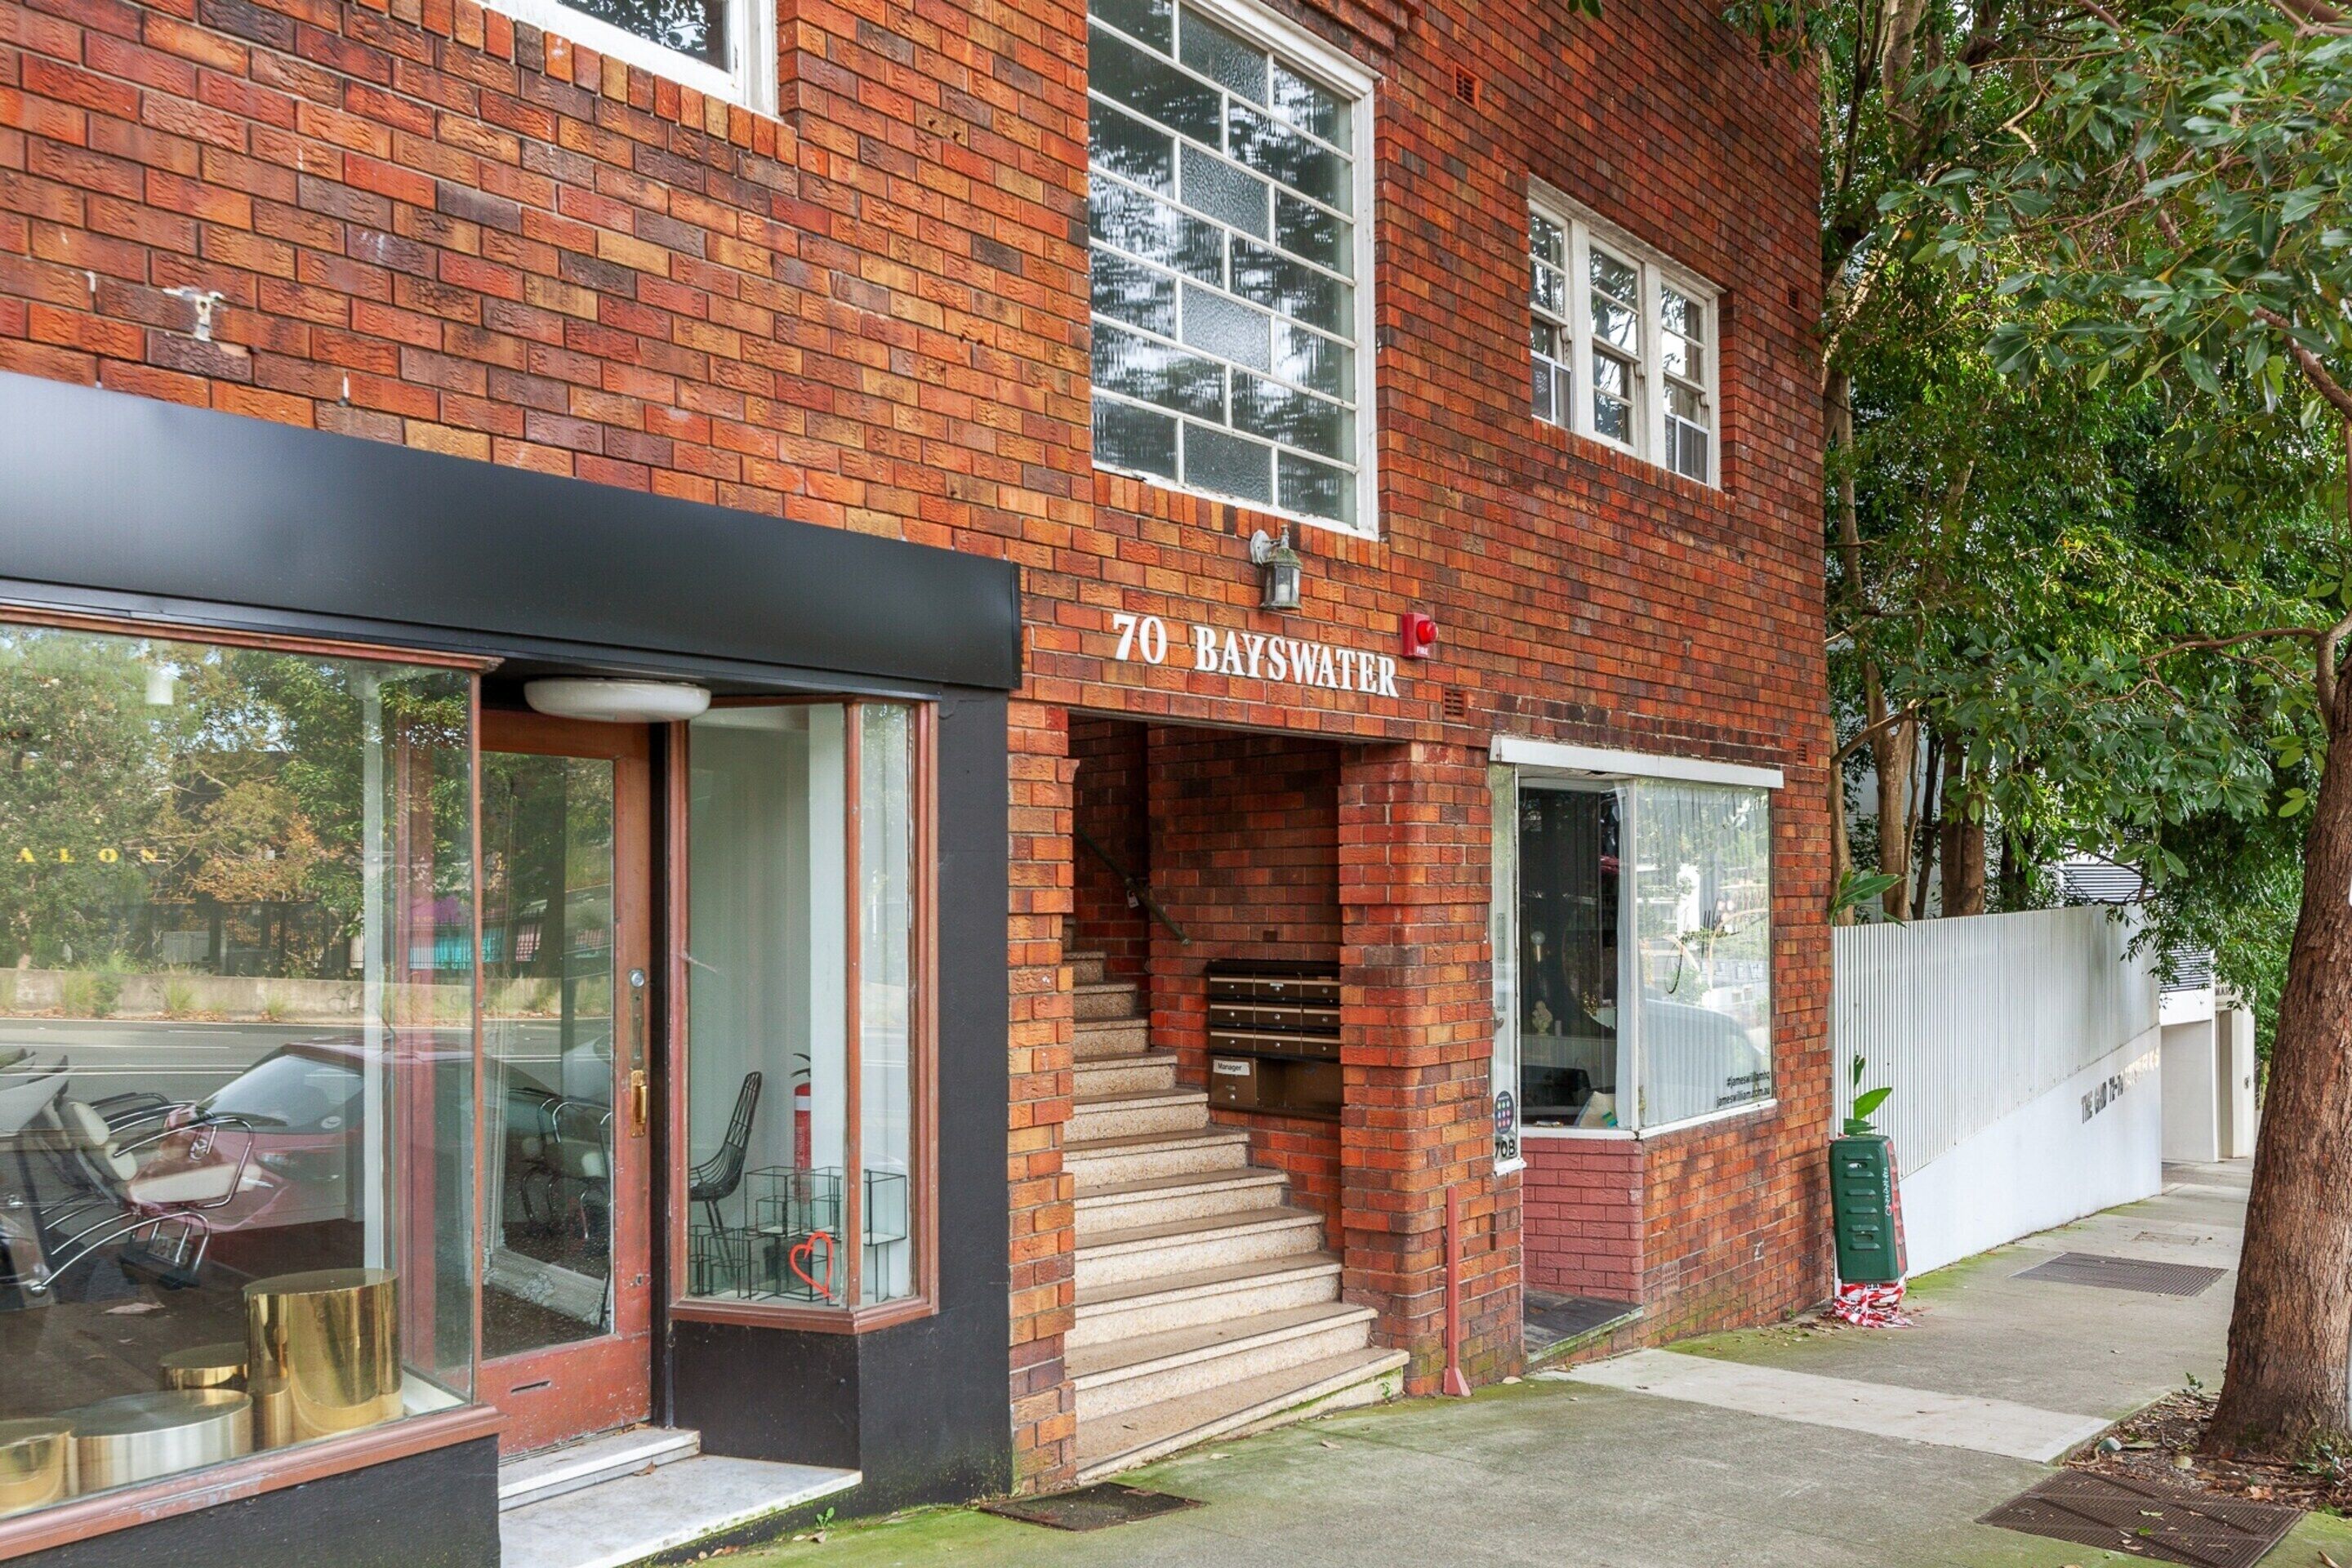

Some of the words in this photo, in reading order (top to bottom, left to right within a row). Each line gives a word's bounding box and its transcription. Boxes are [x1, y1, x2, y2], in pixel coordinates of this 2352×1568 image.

[1112, 612, 1168, 665] 70
[1193, 626, 1400, 697] BAYSWATER
[1416, 645, 1428, 656] FIRE
[1218, 1062, 1242, 1072] Manager
[1494, 1139, 1517, 1159] 70B
